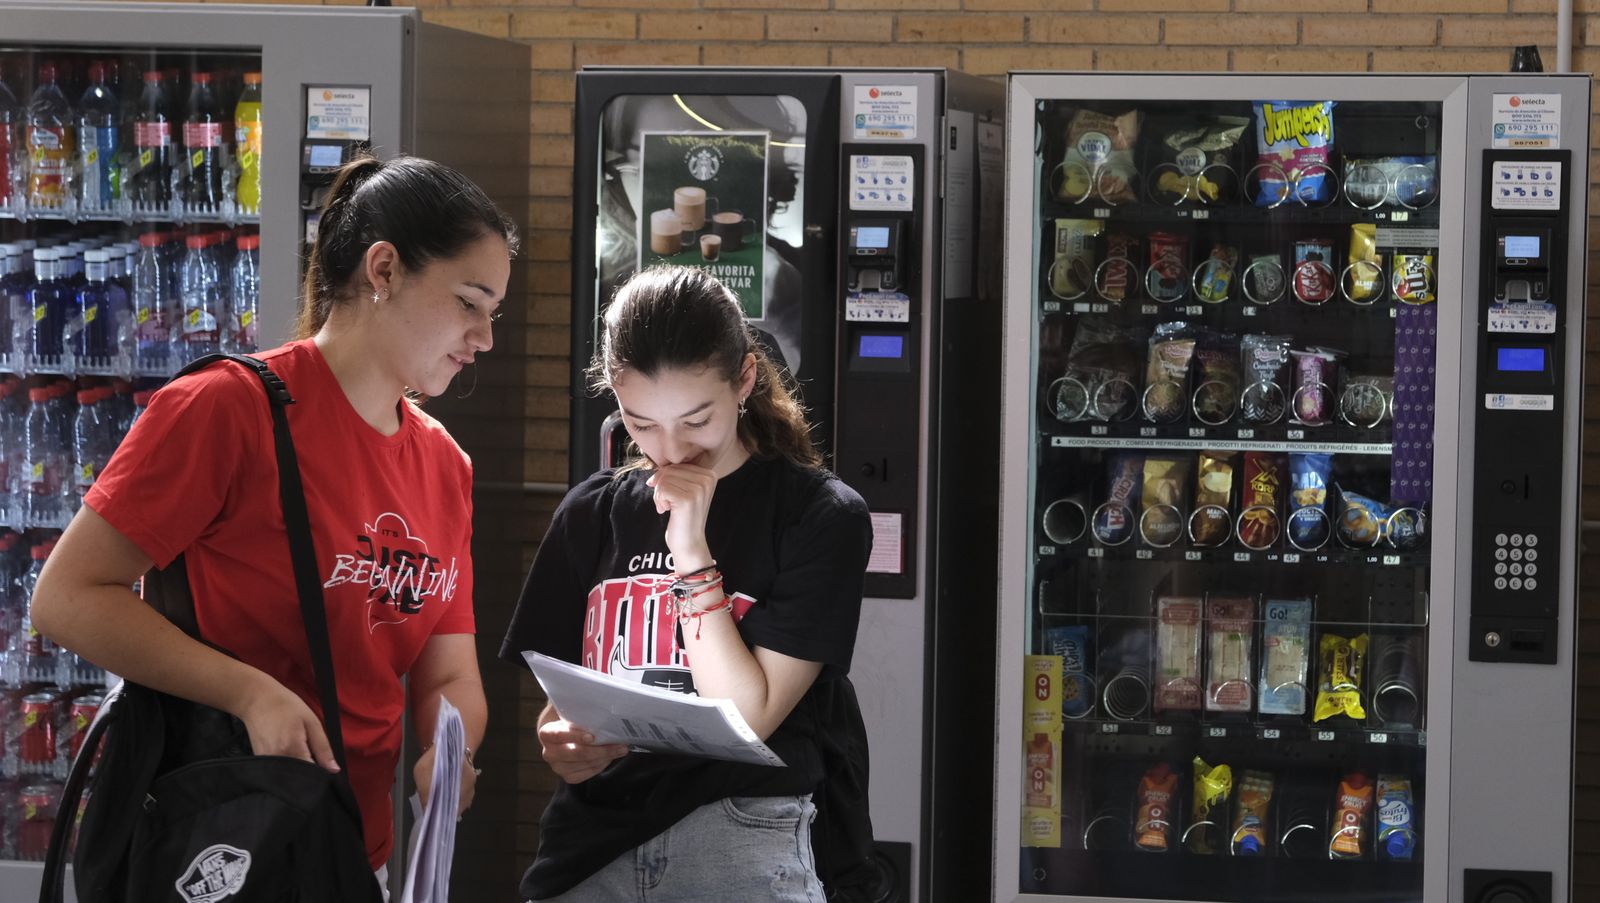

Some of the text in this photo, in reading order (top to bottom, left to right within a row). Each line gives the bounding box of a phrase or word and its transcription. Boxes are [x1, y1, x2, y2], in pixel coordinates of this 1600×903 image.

[1263, 102, 1330, 147] Jumpers
[382, 529, 399, 538] IT'S
[323, 554, 458, 602] BEGINNING
[1270, 608, 1288, 620] Go!
[1038, 678, 1048, 699] ON
[1034, 770, 1043, 791] ON
[197, 851, 226, 877] VANS
[206, 870, 226, 892] THE
